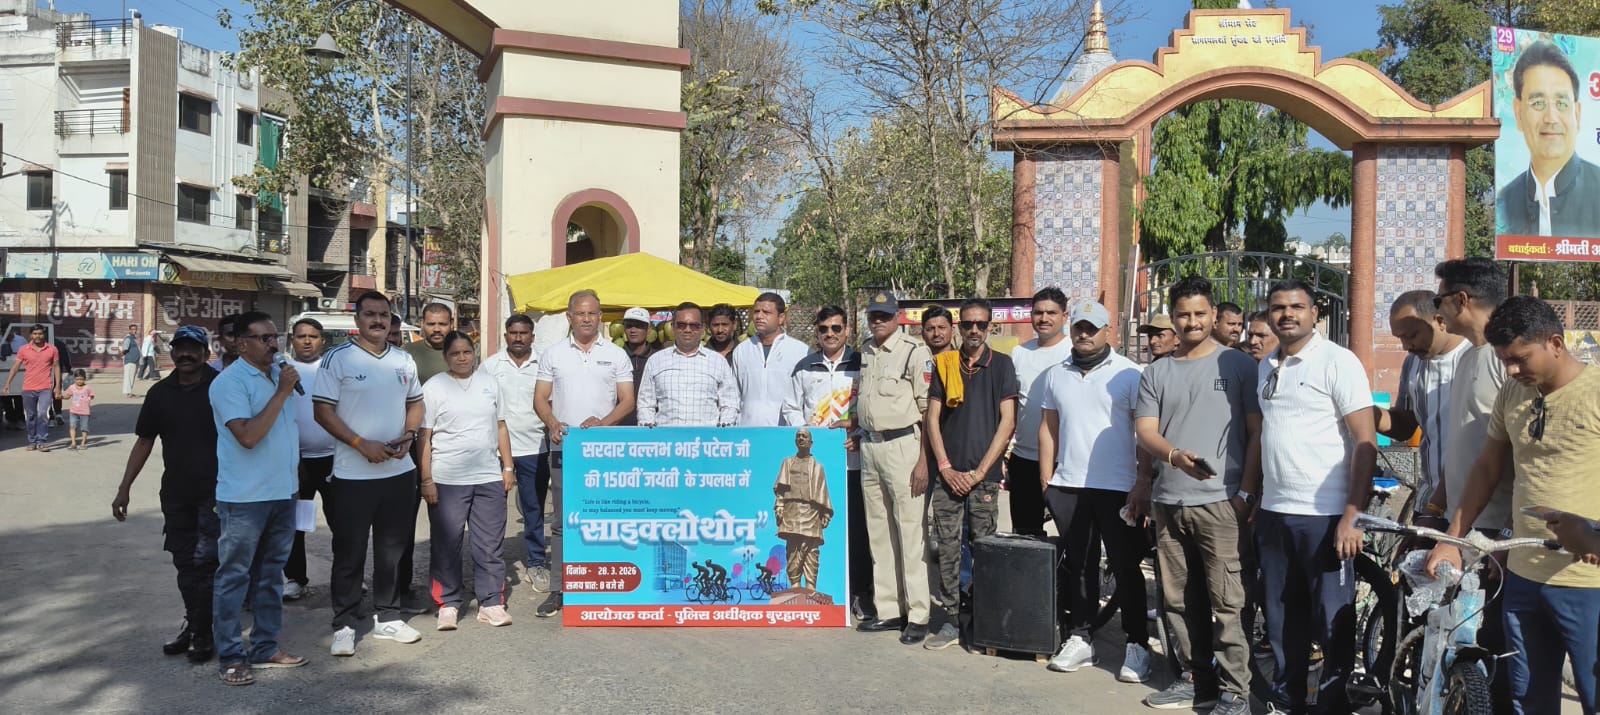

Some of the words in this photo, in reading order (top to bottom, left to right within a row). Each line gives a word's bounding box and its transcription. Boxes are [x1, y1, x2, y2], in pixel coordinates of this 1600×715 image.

[1498, 29, 1513, 43] 29
[1555, 239, 1589, 256] श्रीमती
[112, 256, 138, 267] HARI
[141, 256, 158, 267] OM
[581, 440, 626, 459] सरदार
[628, 441, 673, 459] वल्लभ
[675, 436, 700, 460] भाई
[702, 437, 733, 459] पटेल
[735, 438, 751, 458] जी
[584, 469, 601, 488] की
[603, 467, 643, 488] 150वीं
[643, 467, 681, 488] जयंती
[684, 469, 697, 488] के
[699, 472, 737, 488] उपलक्ष
[738, 470, 752, 488] में
[612, 498, 627, 507] riding
[646, 507, 658, 515] keep
[566, 565, 588, 575] दिनांक
[598, 566, 609, 575] 28.
[619, 566, 637, 575] 2026
[565, 581, 584, 590] समय
[605, 579, 617, 590] बजे
[617, 579, 625, 590] से
[580, 607, 635, 621] आयोजक
[638, 607, 664, 621] कर्ता
[675, 607, 710, 625] पुलिस
[713, 607, 763, 621] अधीक्षक
[766, 610, 821, 625] बुरहानपुर
